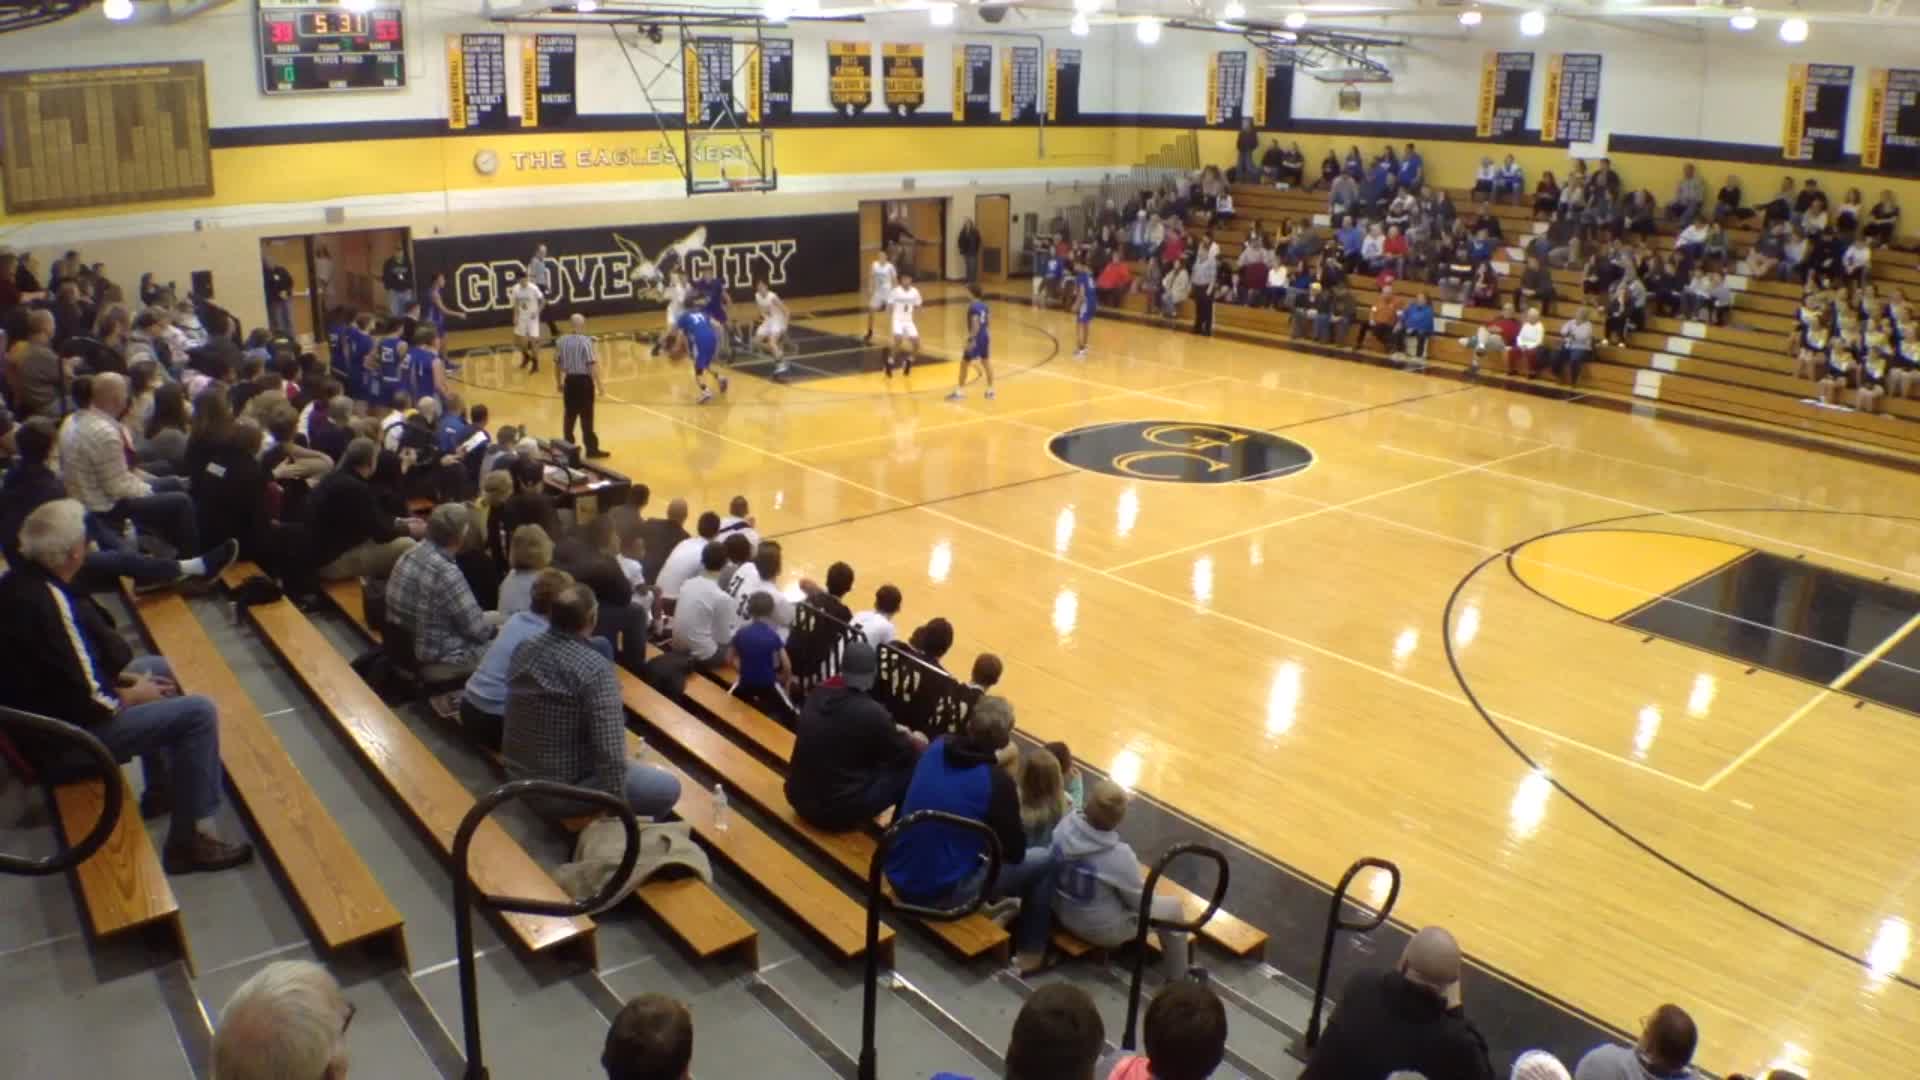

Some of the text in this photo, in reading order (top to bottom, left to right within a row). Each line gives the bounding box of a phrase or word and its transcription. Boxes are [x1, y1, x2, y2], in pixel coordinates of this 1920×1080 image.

[314, 15, 328, 33] 5
[512, 150, 567, 171] THE
[455, 239, 797, 313] GROVE CITY
